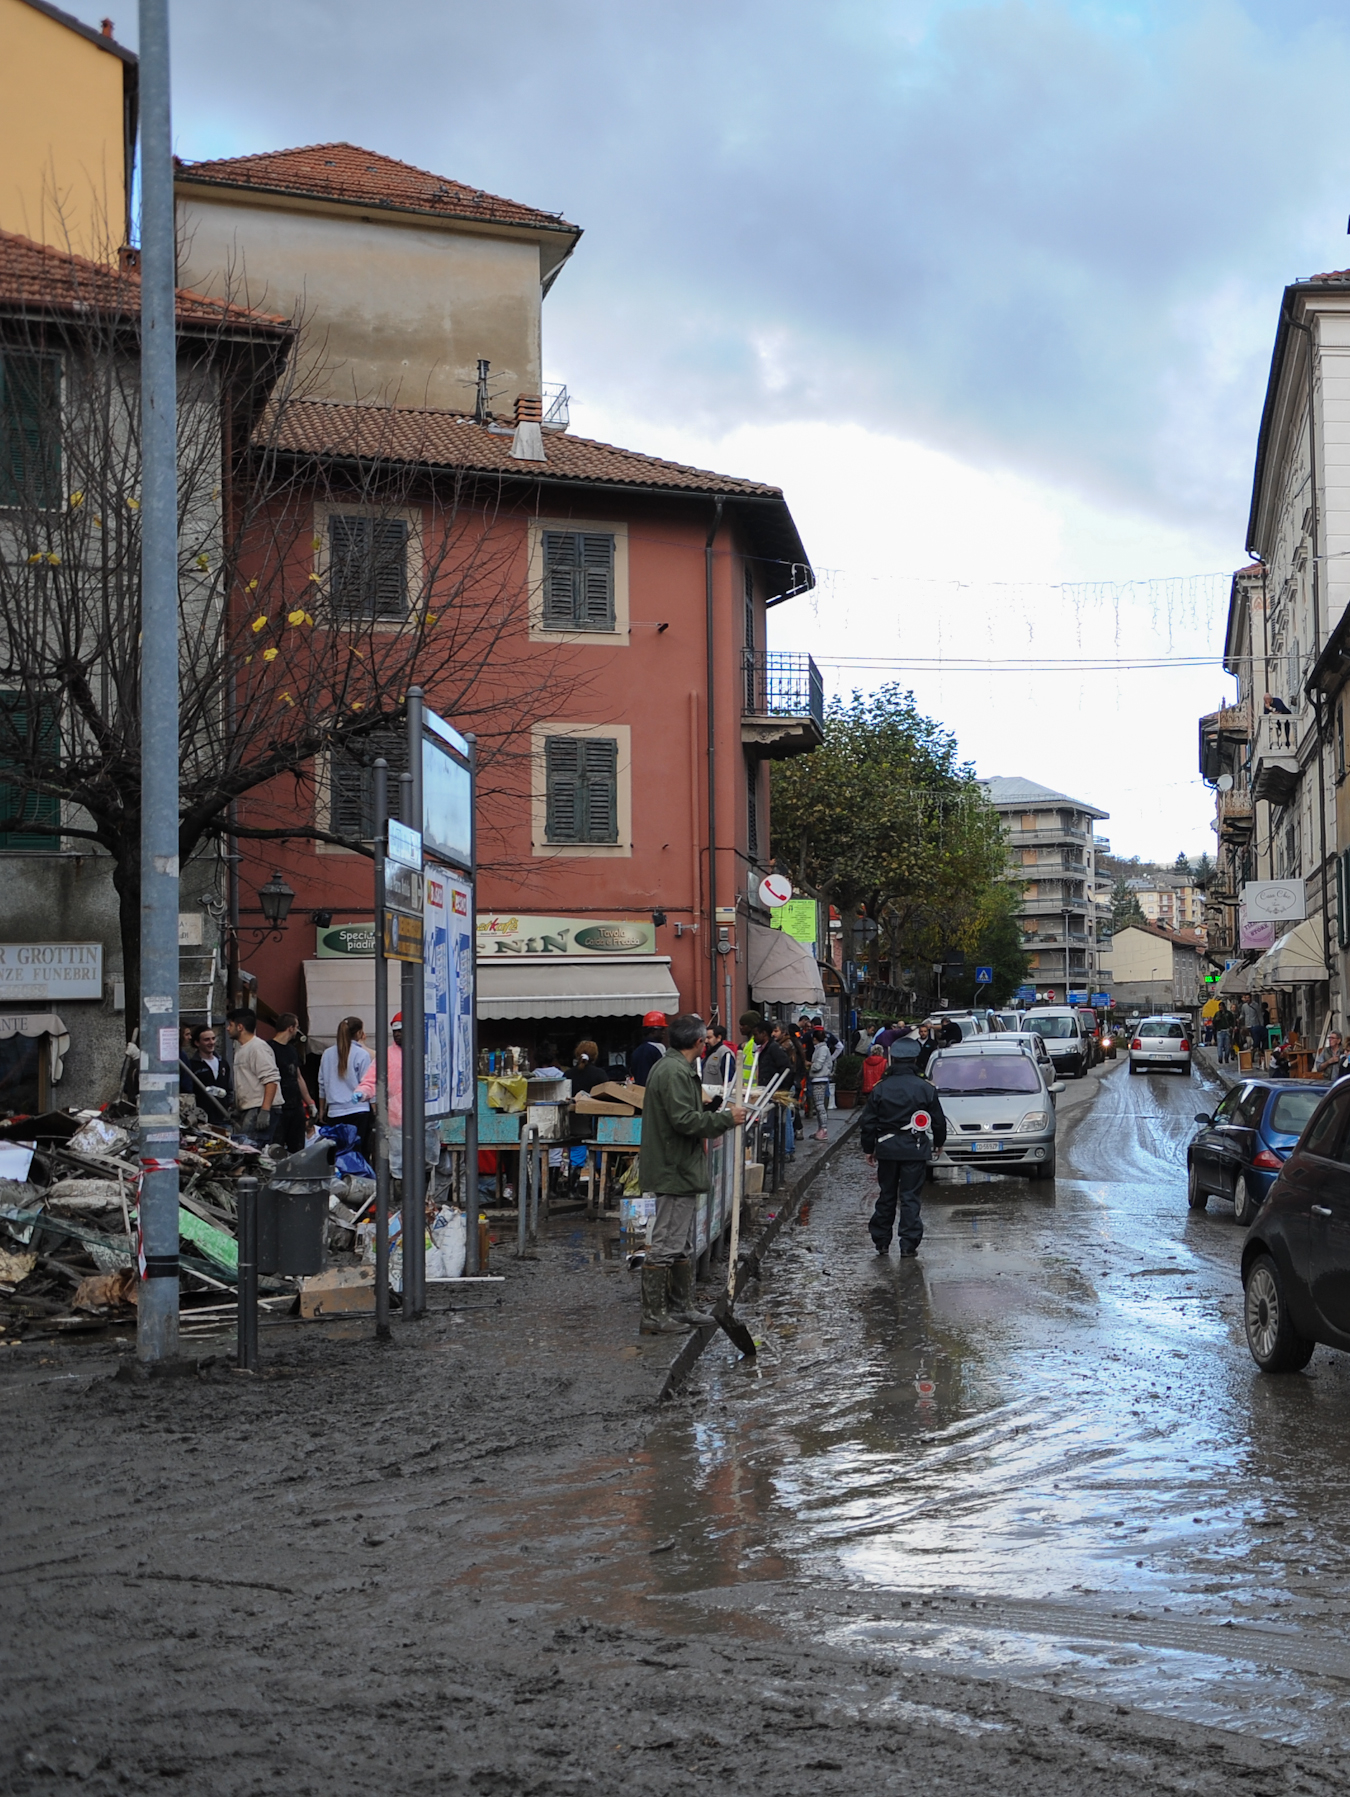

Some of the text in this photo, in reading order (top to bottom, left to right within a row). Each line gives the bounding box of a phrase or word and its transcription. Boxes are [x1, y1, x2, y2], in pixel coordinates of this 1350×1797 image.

[598, 928, 625, 938] Tavola
[17, 947, 98, 965] GROTTIN
[33, 967, 97, 980] FUNEBRI
[0, 1017, 28, 1032] NTE
